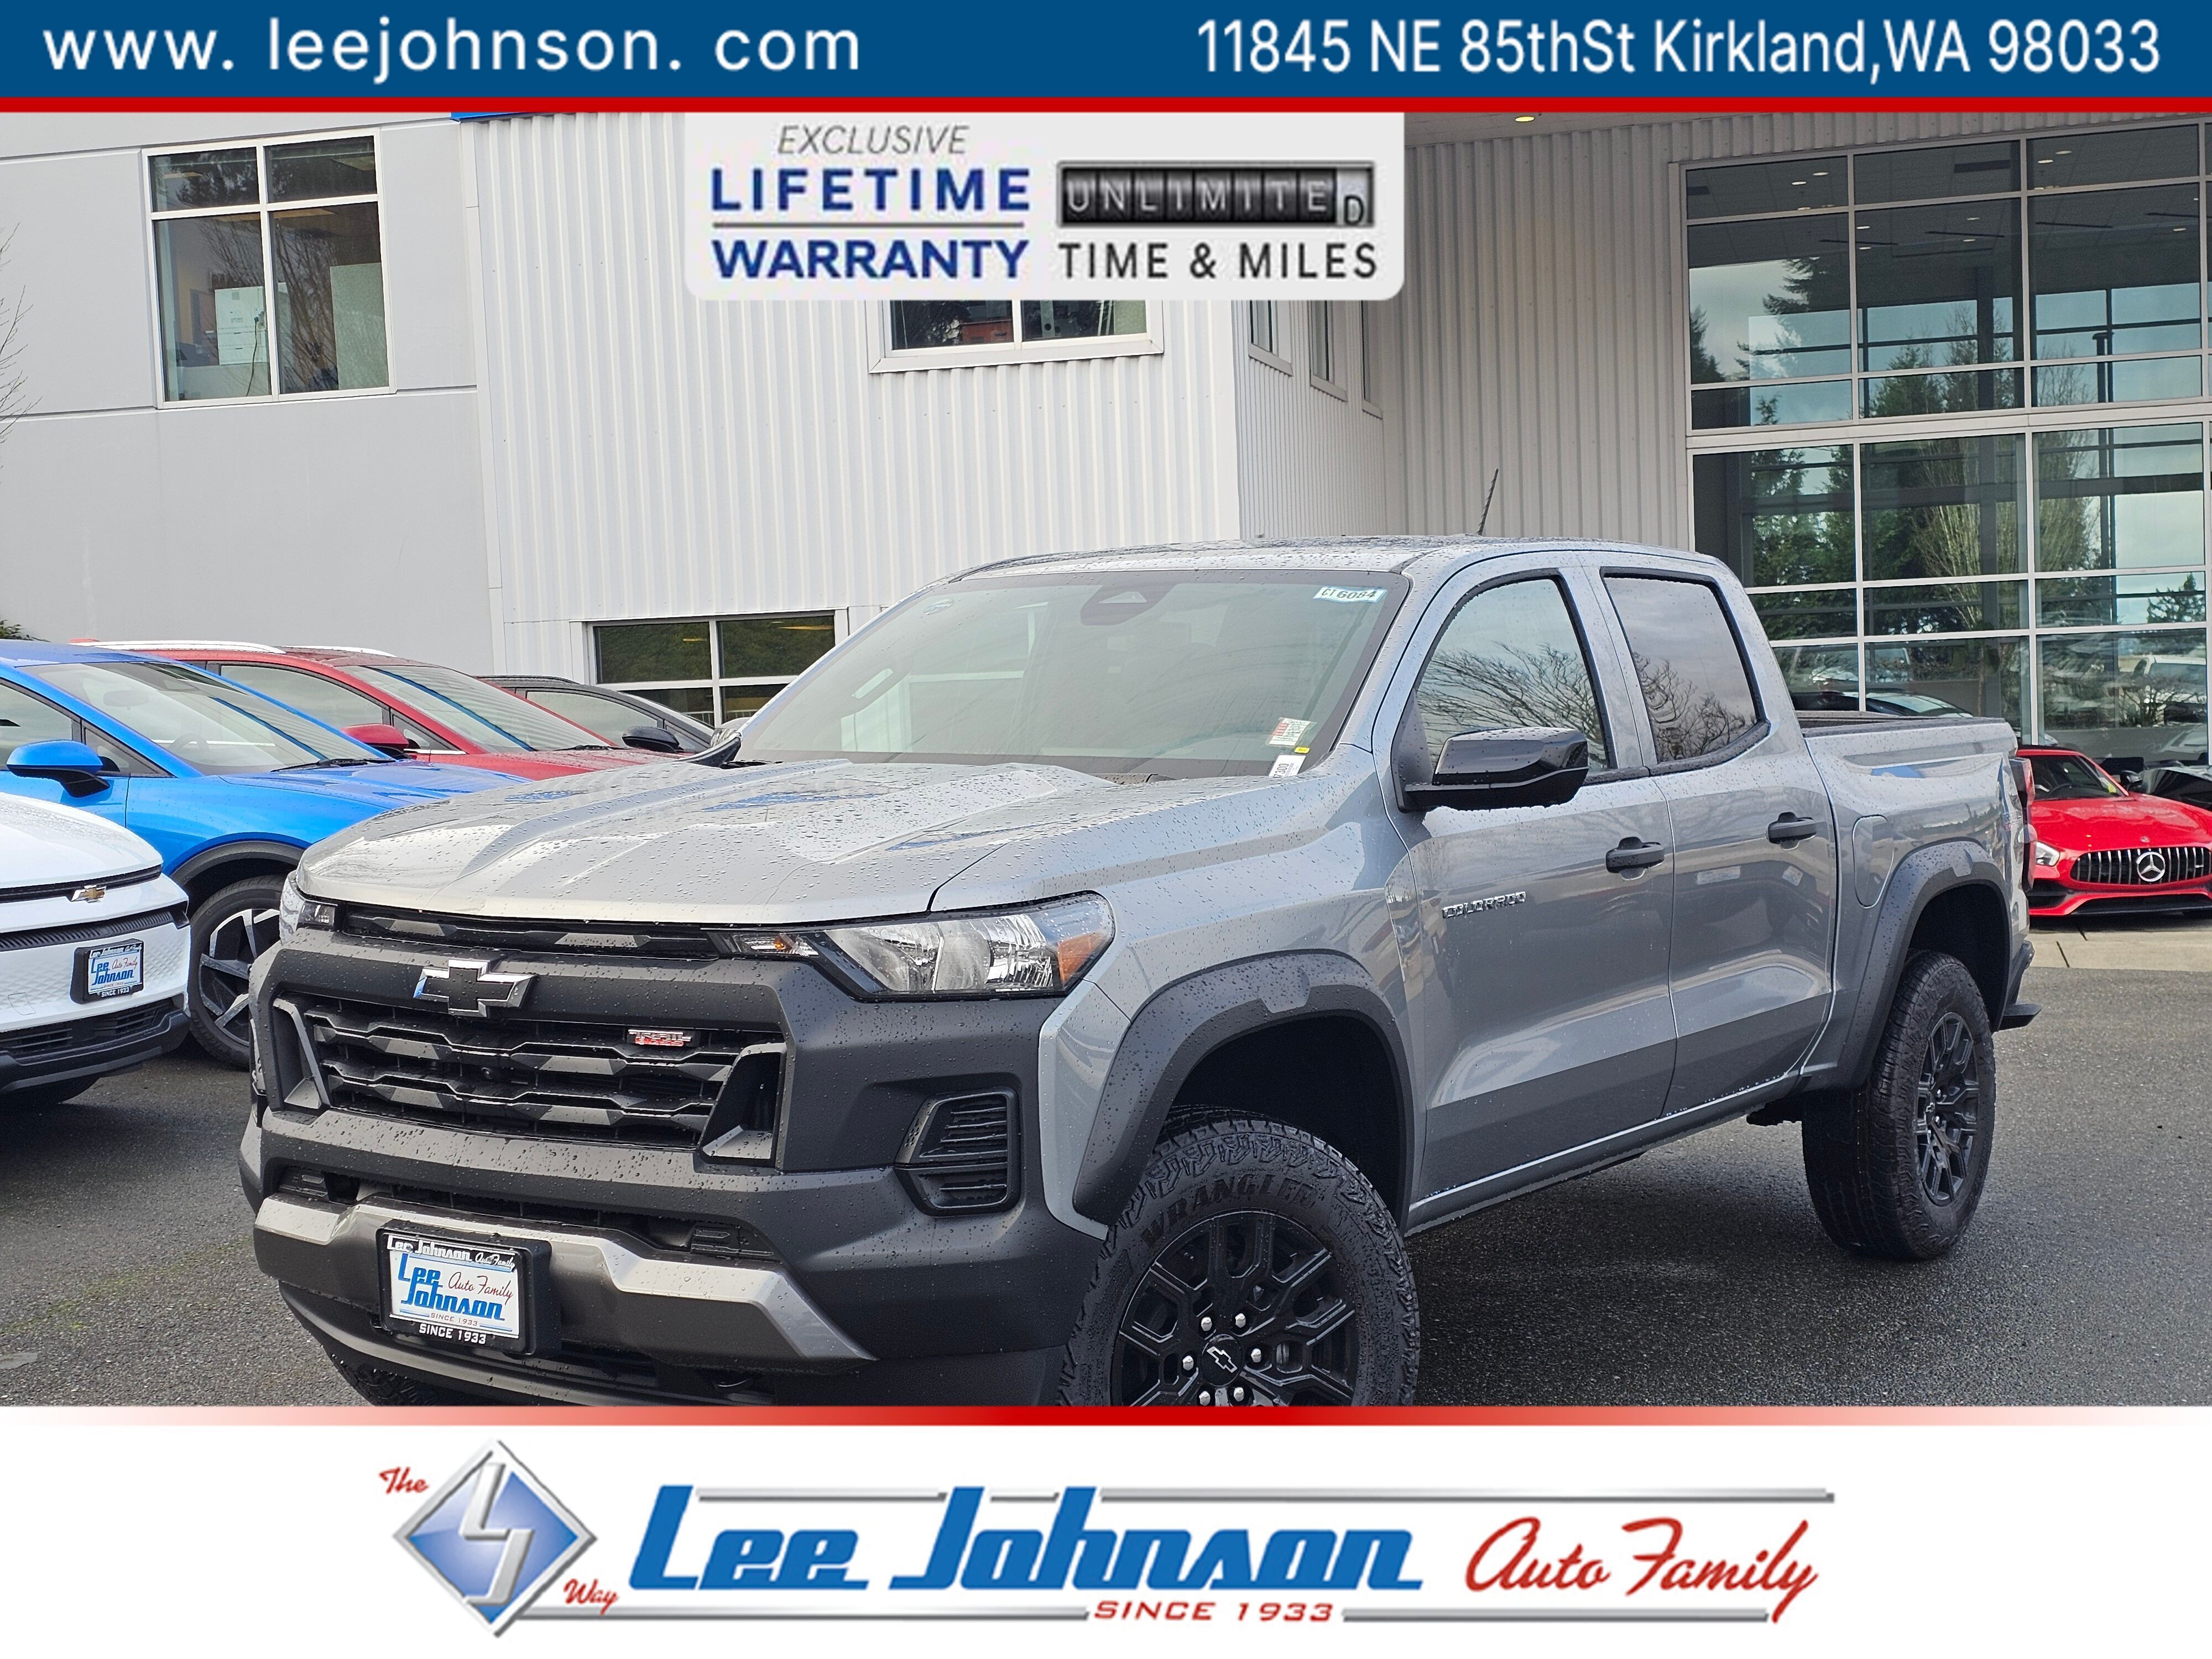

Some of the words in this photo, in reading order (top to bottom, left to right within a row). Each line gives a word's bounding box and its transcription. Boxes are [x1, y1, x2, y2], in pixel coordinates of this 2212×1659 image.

[91, 958, 110, 973] Lee
[92, 968, 134, 985] Johnson
[387, 1234, 414, 1253] Lee
[415, 1239, 473, 1262] Johnson
[398, 1253, 443, 1287] Lee
[400, 1279, 505, 1321] Johnson
[448, 1272, 474, 1292] Auto
[477, 1275, 513, 1305] Family
[430, 1312, 455, 1322] SINCE
[458, 1317, 478, 1327] 1933
[419, 1323, 453, 1339] SINCE
[457, 1330, 487, 1345] 1933
